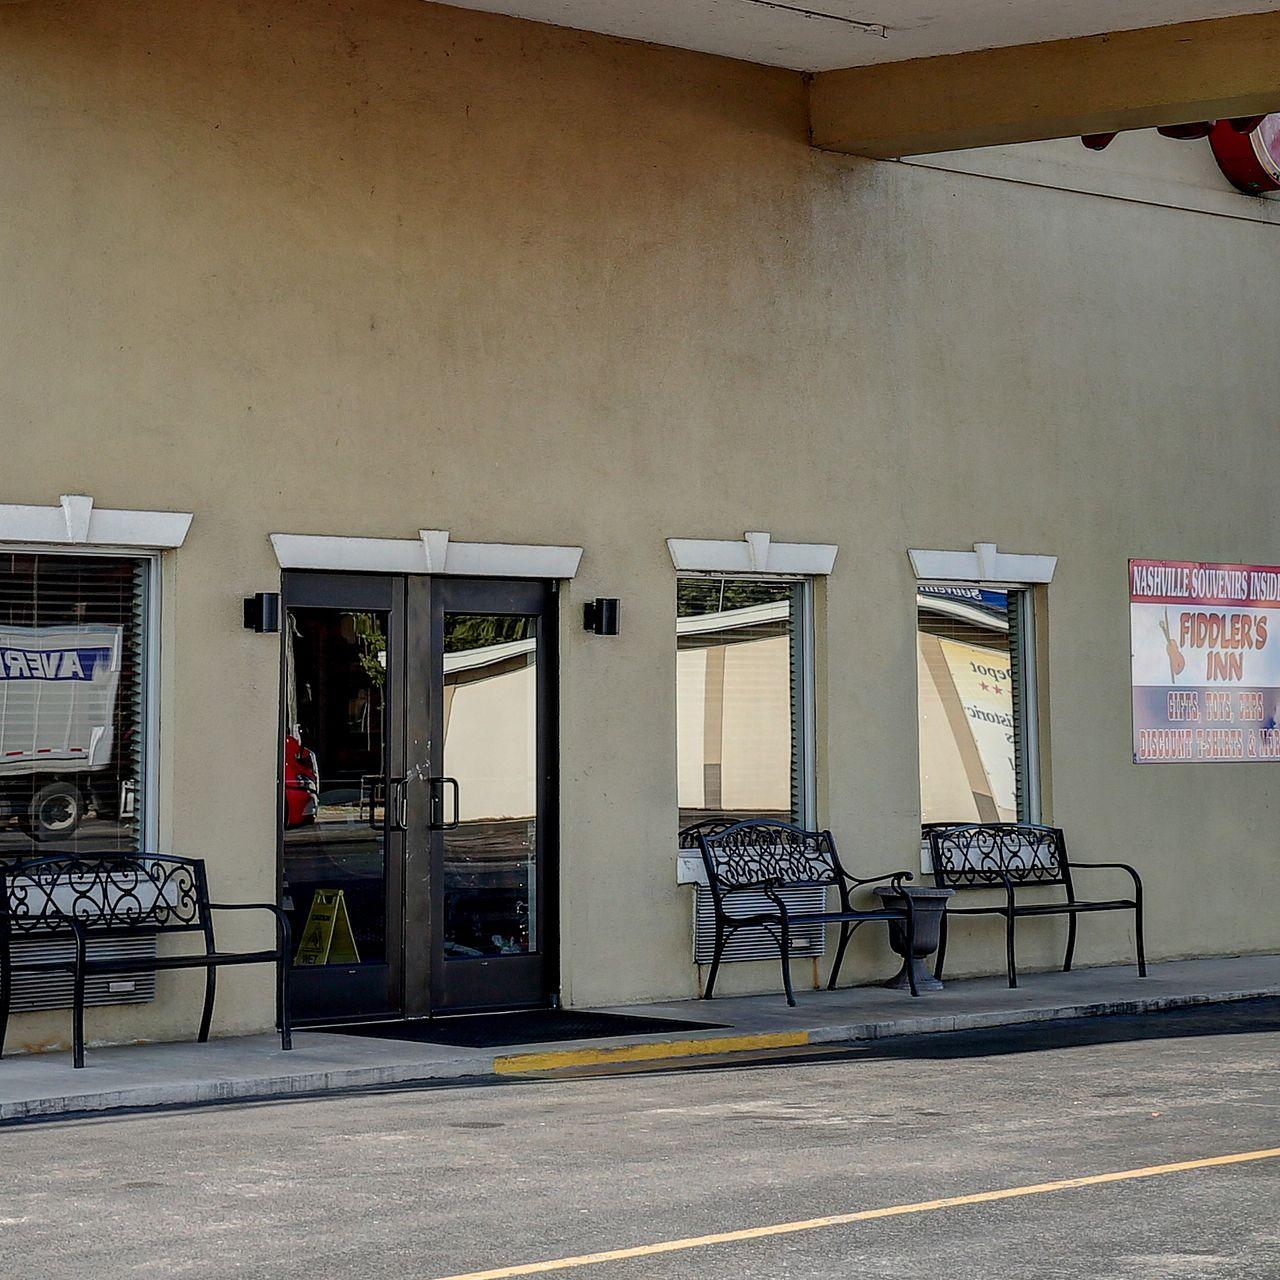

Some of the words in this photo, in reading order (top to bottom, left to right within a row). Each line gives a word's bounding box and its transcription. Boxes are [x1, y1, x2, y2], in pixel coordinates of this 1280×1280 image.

[1132, 565, 1190, 597] NASHVILLE
[1191, 568, 1248, 601] SOUVENIRS
[1180, 612, 1268, 650] FIDDLER'S
[1206, 650, 1244, 681] INN
[1167, 691, 1201, 723] GIFTS,
[1139, 728, 1193, 760] DISCOUNT
[1195, 728, 1243, 760] T-SHIRTS
[1248, 728, 1257, 758] &
